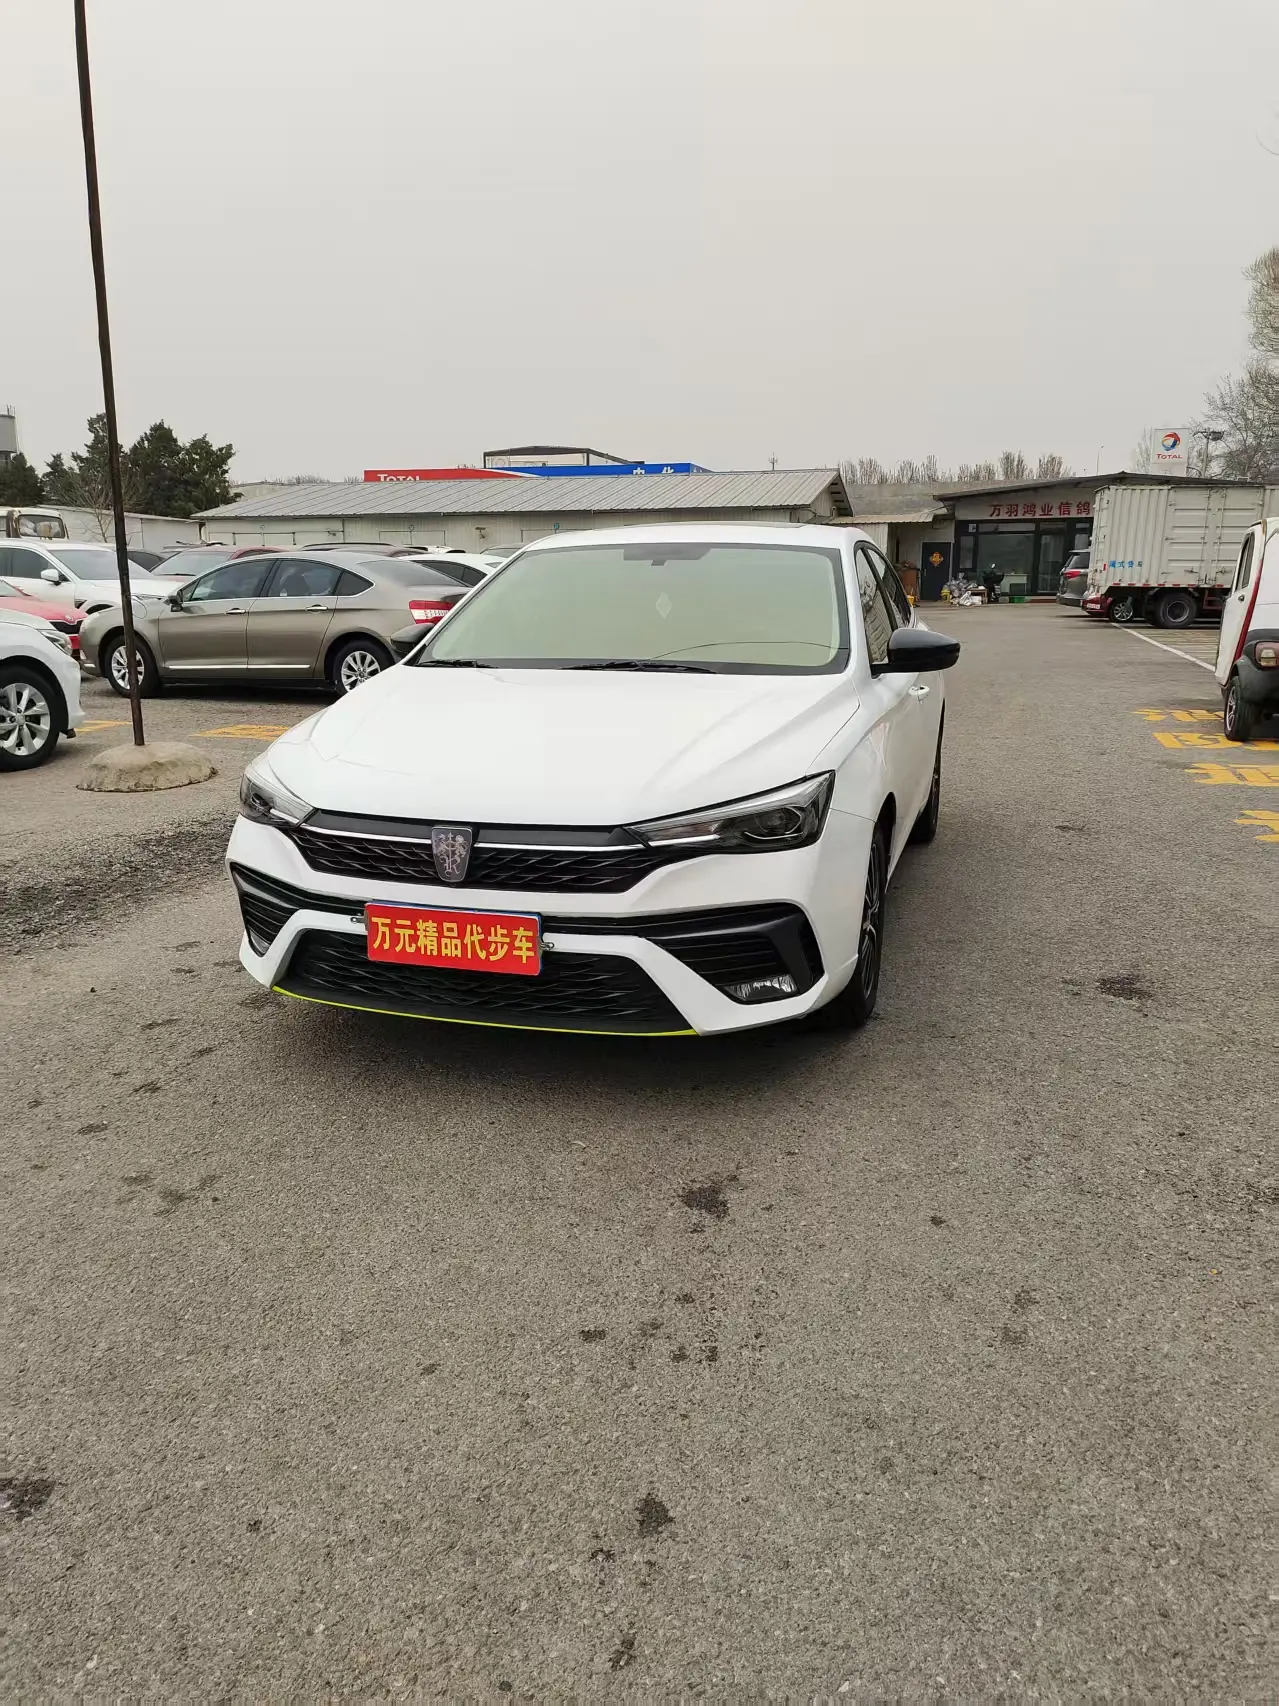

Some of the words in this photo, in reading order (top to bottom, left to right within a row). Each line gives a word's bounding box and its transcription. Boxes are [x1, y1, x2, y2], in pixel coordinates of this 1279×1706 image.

[988, 501, 1091, 517] 万羽鸿业信鸽
[371, 916, 535, 964] 万元精品代步车
